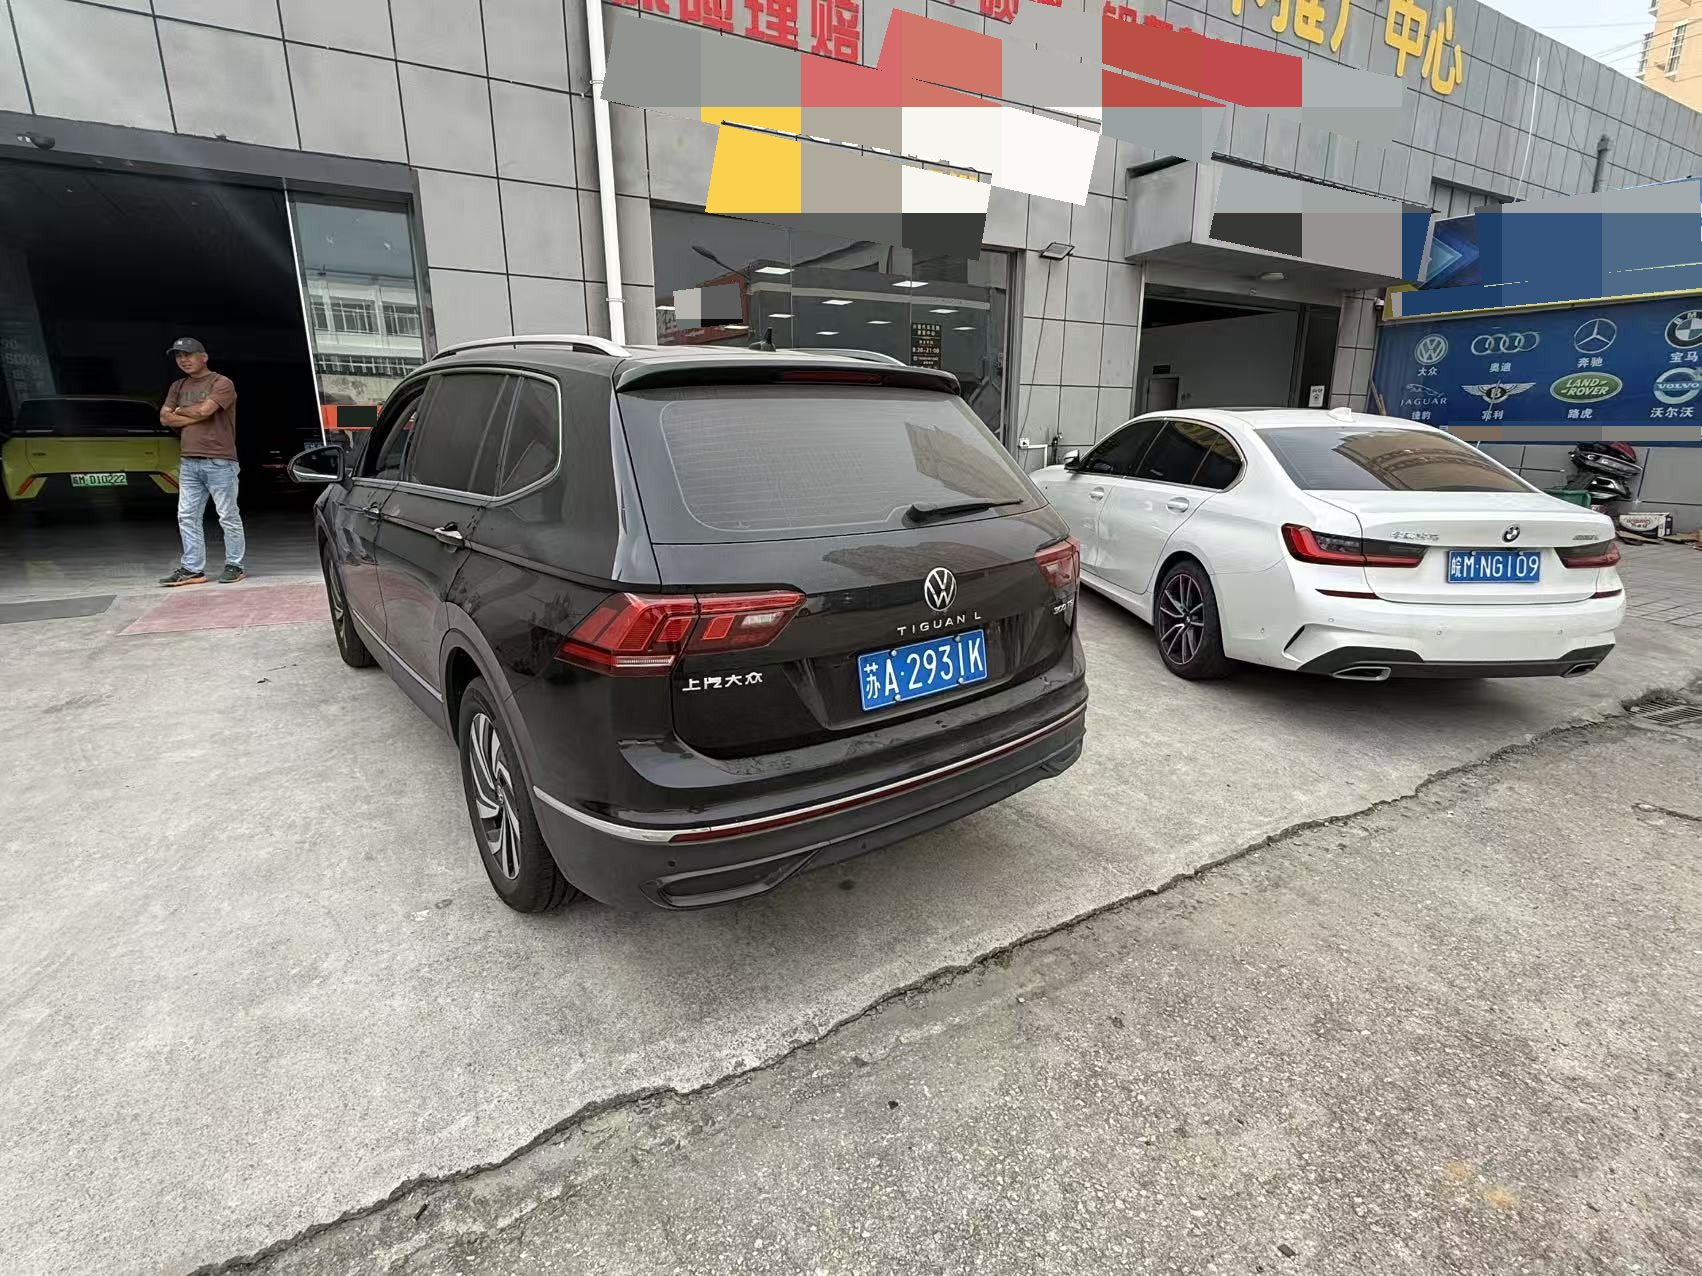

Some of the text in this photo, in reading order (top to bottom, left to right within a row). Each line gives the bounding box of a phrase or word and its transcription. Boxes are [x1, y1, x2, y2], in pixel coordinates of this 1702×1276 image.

[1231, 0, 1463, 95] 推广中心
[1577, 356, 1603, 368] 奔驰
[1669, 351, 1698, 363] 宝马
[1417, 366, 1438, 376] 大众
[1489, 362, 1511, 372] 奥迪
[1566, 379, 1600, 387] LAND
[1566, 386, 1609, 396] ROVER
[1400, 397, 1447, 407] JAGUAR
[1567, 408, 1593, 419] 路虎
[1649, 406, 1694, 418] 沃尔沃
[897, 611, 982, 636] TIGUAN L
[682, 671, 763, 691] 上汽大众
